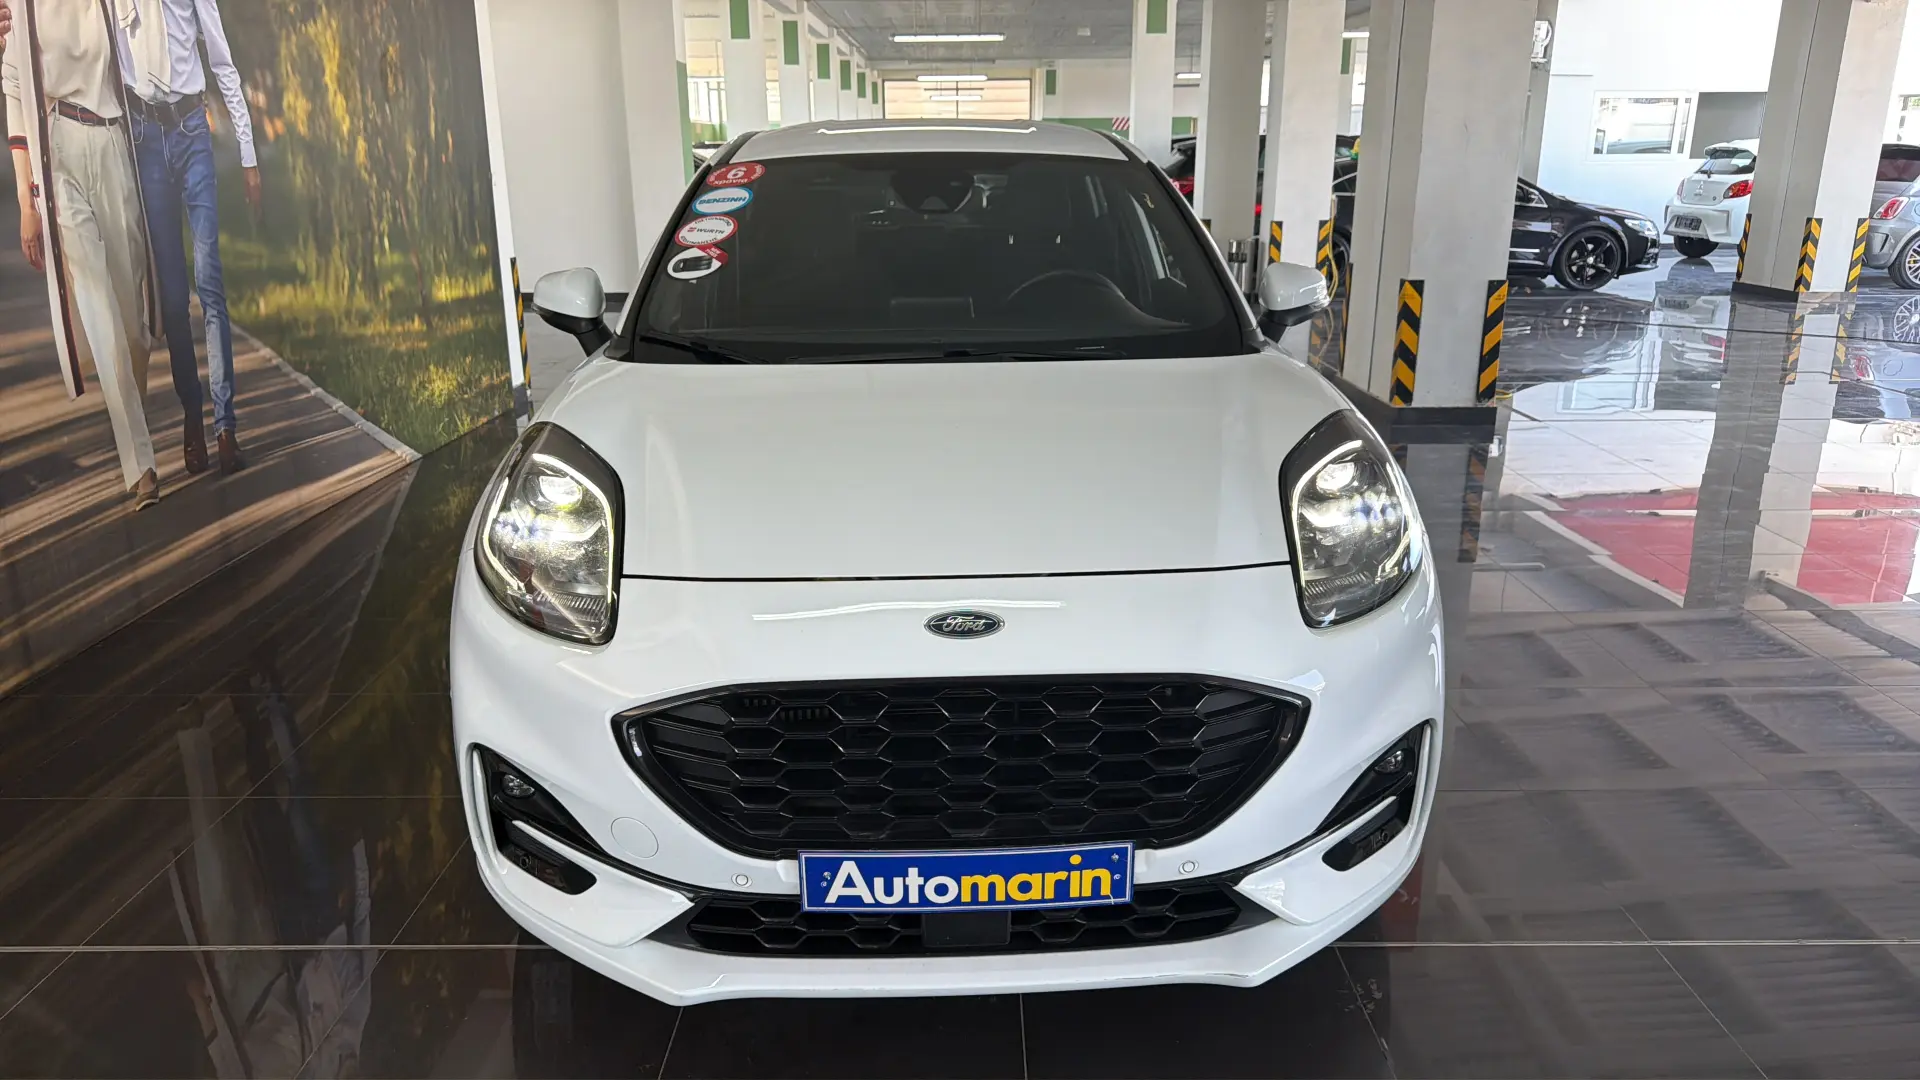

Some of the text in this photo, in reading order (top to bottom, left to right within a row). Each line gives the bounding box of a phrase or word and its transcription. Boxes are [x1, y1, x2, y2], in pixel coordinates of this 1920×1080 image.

[727, 167, 747, 179] 6
[934, 615, 990, 632] Ford
[824, 854, 1112, 904] Automarin
